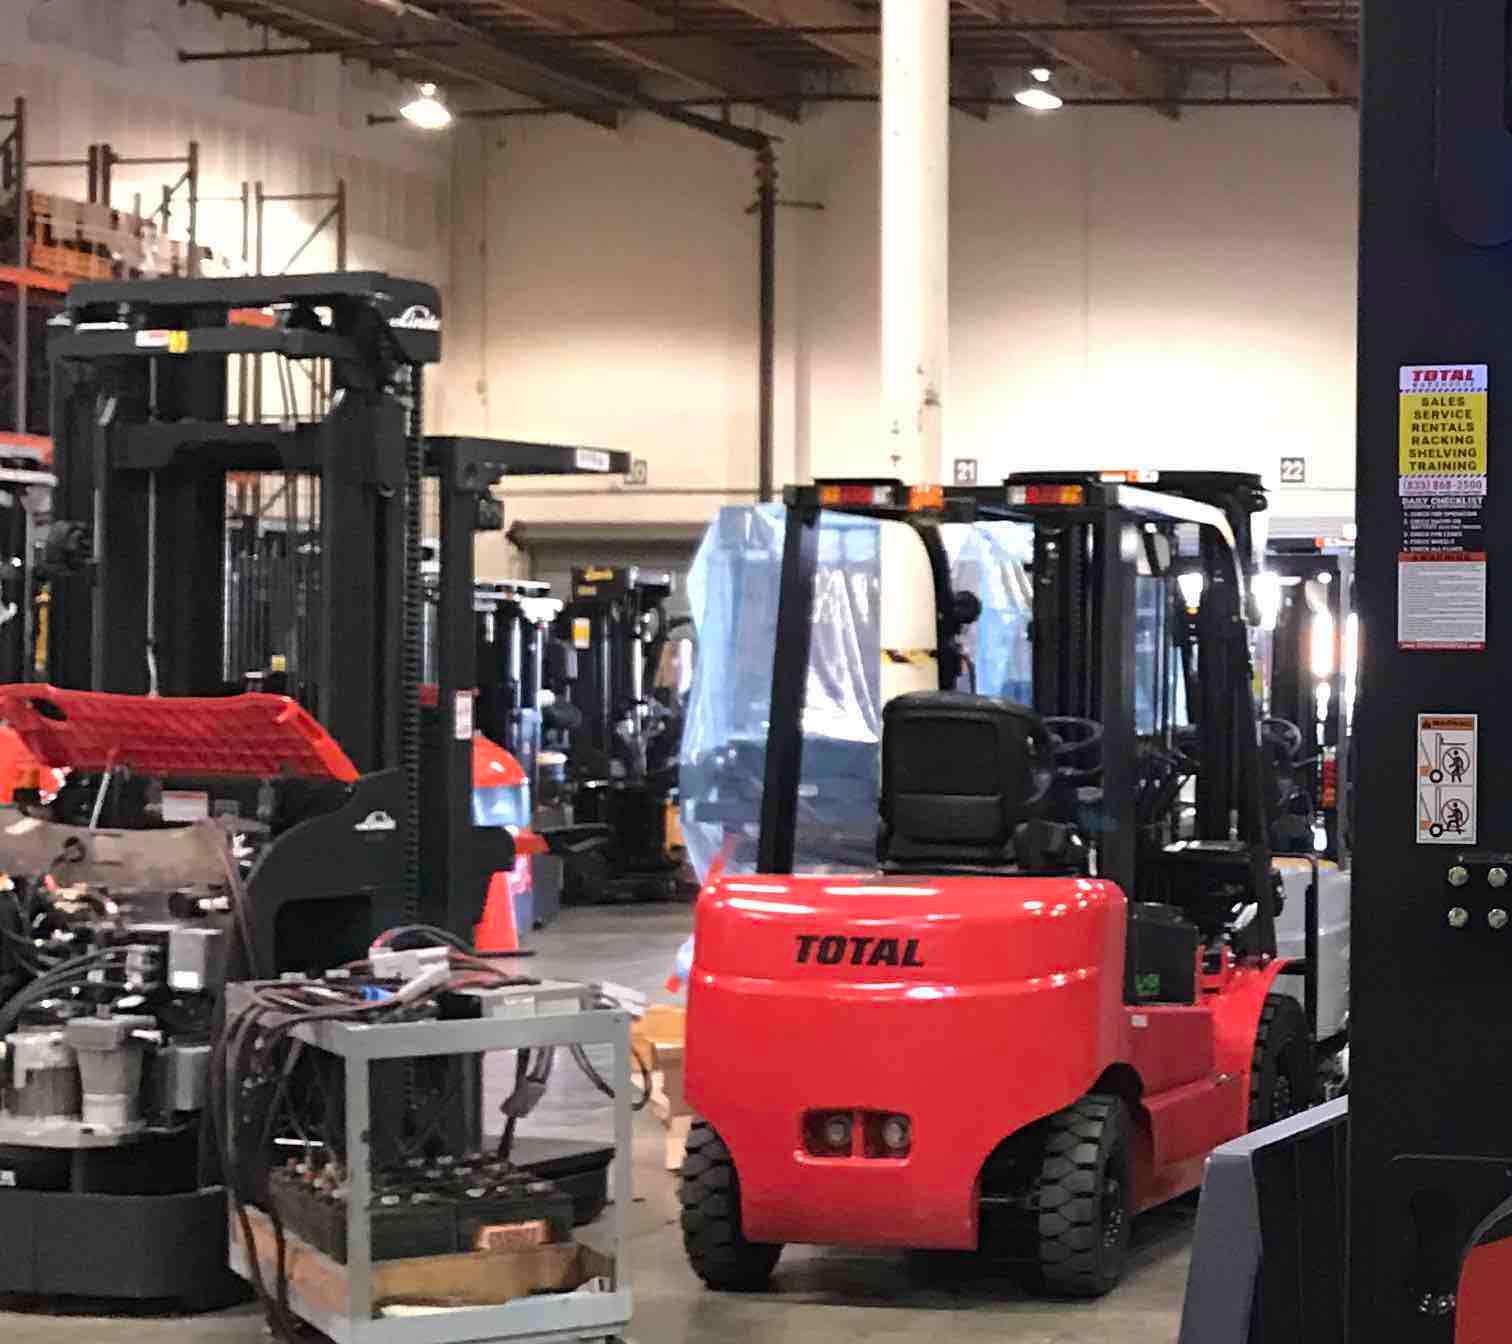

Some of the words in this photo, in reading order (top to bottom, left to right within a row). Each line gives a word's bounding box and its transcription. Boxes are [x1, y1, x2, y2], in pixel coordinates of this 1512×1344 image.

[1412, 369, 1474, 382] TOTAL
[1421, 396, 1465, 407] SALES
[1414, 409, 1473, 420] SERVICE
[1411, 422, 1475, 432] RENTALS
[1411, 435, 1475, 445] RACKING
[1408, 447, 1477, 458] SHELVING
[1282, 460, 1303, 480] 22
[1408, 460, 1477, 471] TRAINING
[795, 935, 924, 967] TOTAL
